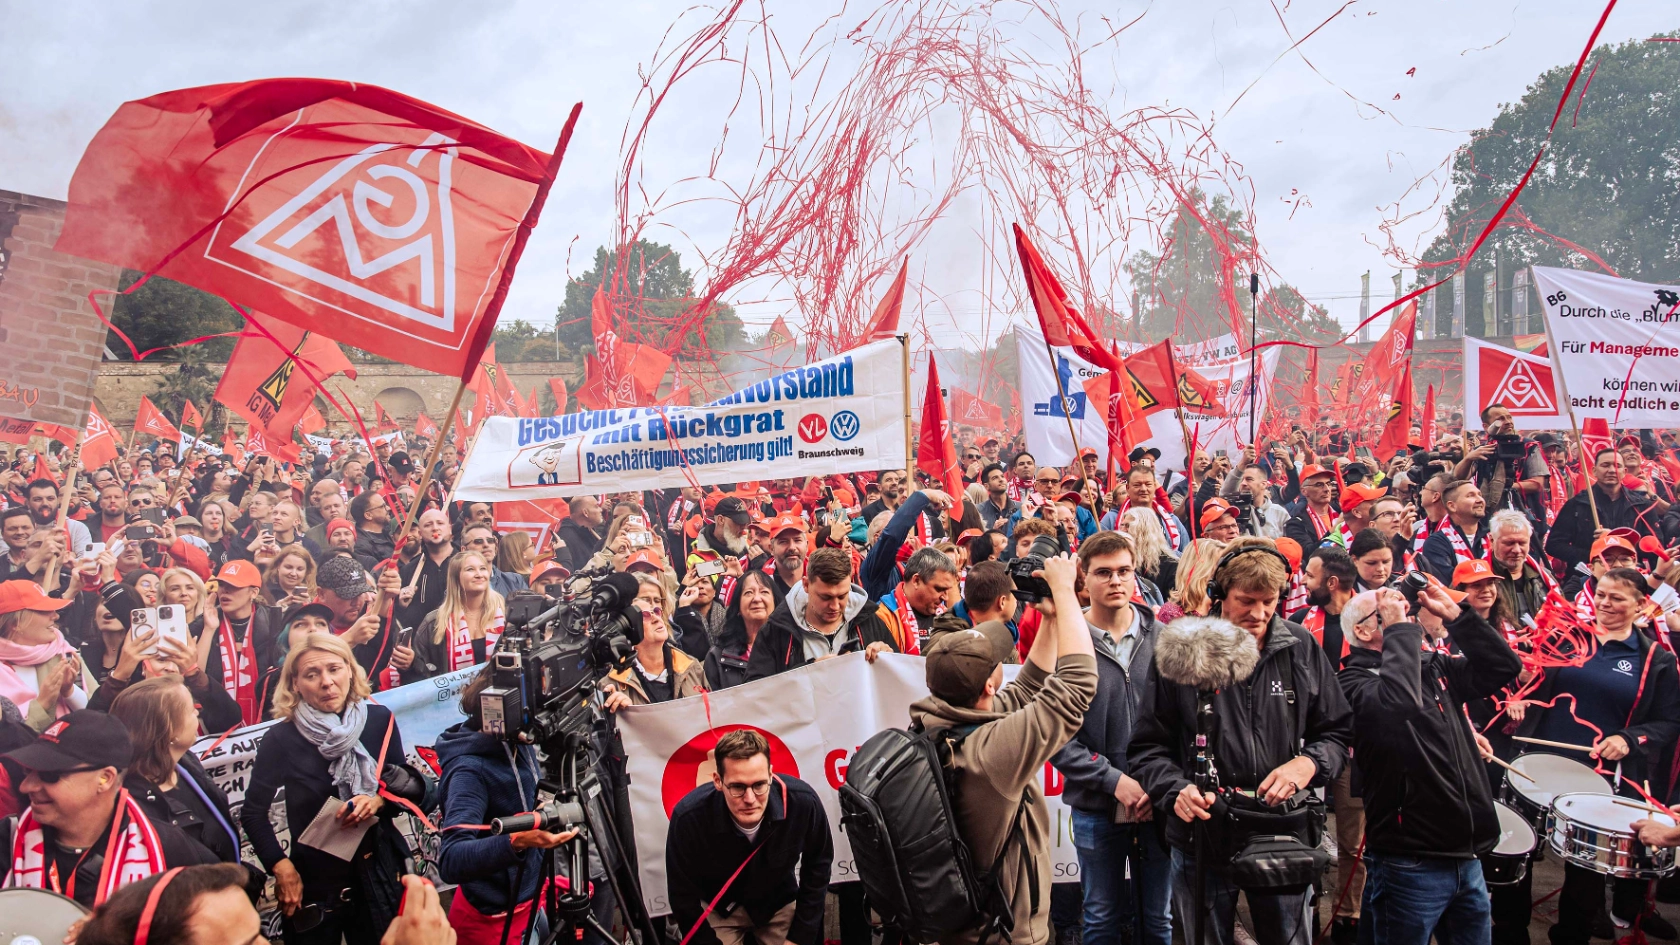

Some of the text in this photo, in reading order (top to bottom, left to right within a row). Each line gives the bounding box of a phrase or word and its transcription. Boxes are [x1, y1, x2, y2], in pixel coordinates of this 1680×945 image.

[1546, 290, 1567, 307] B6
[1560, 305, 1606, 319] Durch
[1610, 309, 1631, 321] die
[1224, 345, 1239, 357] AG
[1561, 341, 1679, 358] Für Manageme
[1603, 378, 1680, 393] können wi
[1569, 394, 1605, 408] acht
[1608, 397, 1666, 410] endlich
[648, 409, 785, 441] Rückgrat
[586, 435, 793, 474] Beschäftigungssicherung gilt!
[798, 446, 864, 459] Braunschweig
